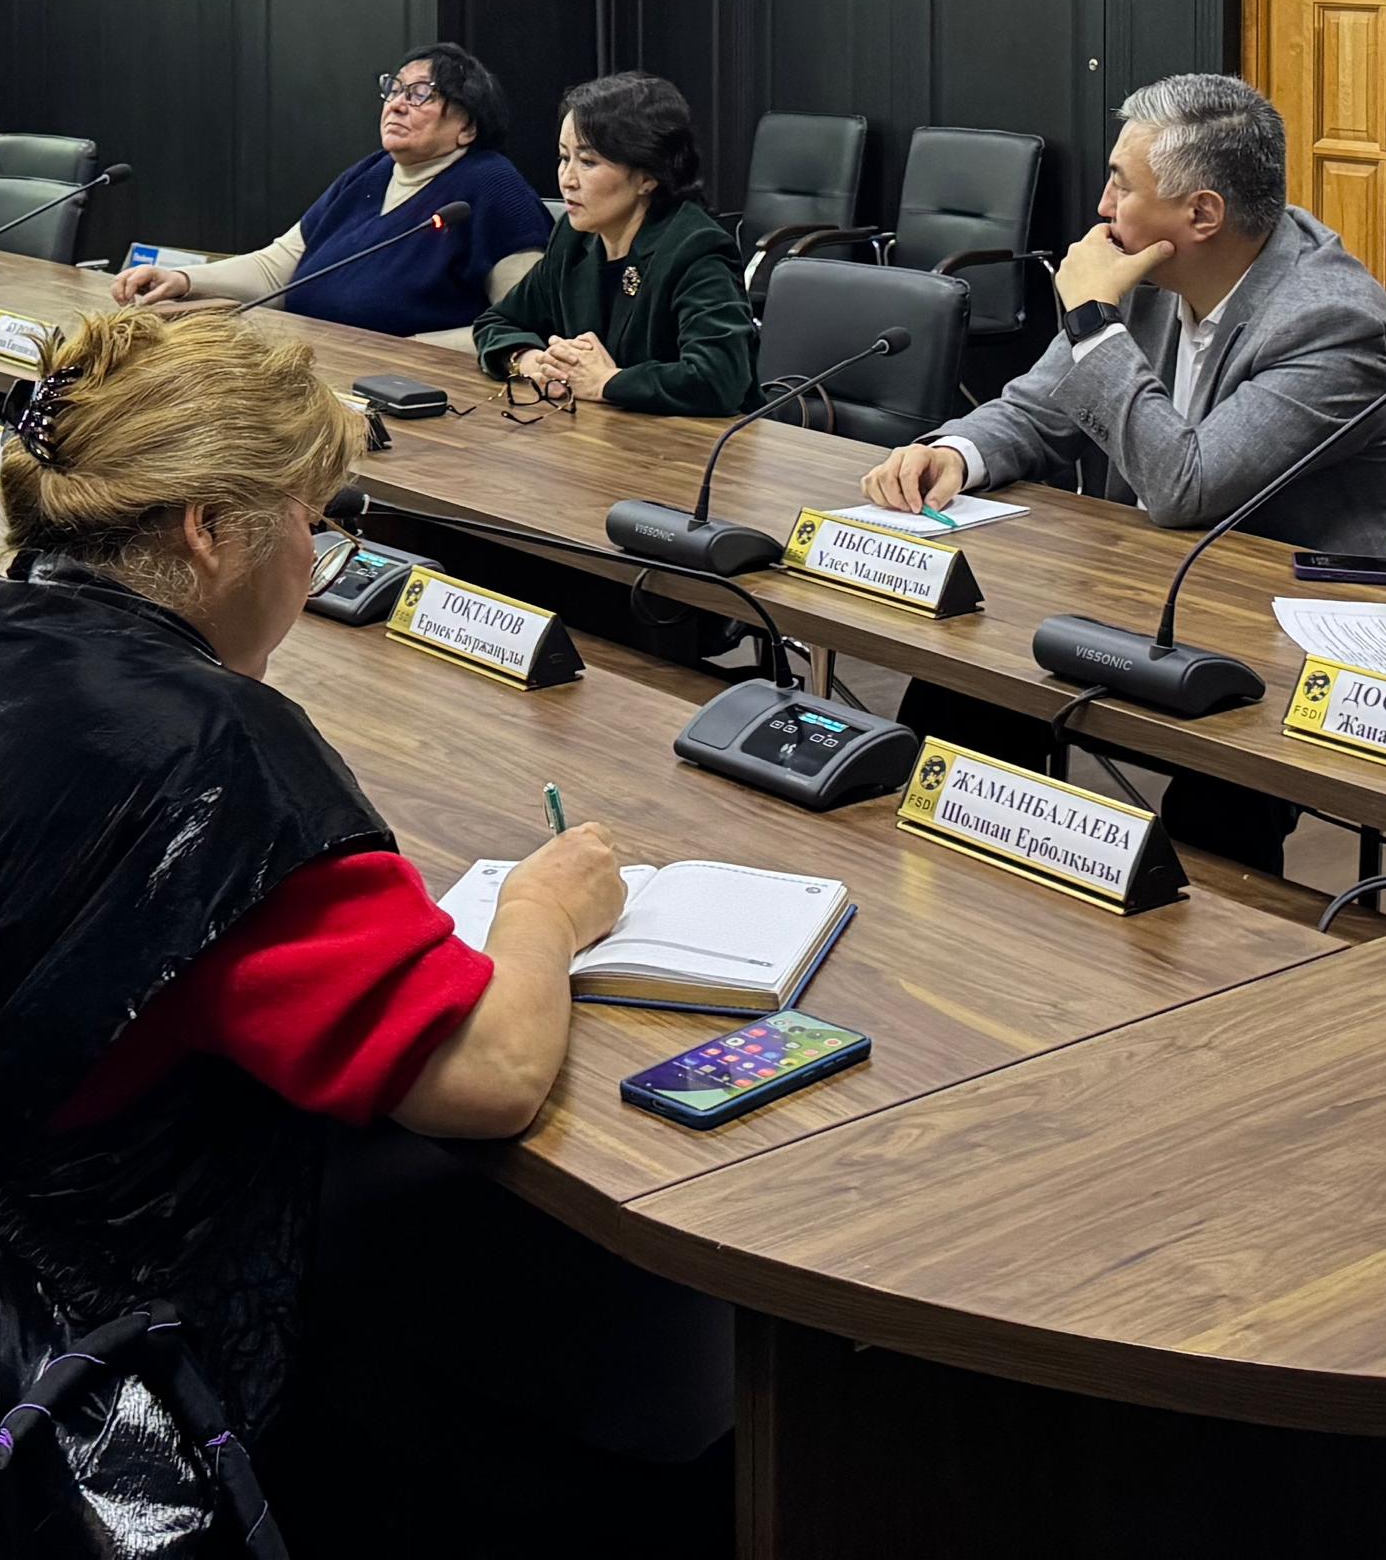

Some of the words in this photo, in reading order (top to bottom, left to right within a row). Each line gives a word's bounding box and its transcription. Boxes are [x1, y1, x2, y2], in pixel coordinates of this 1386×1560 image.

[833, 530, 933, 571] НЫСАНБЕК
[417, 613, 455, 639] Ермек
[442, 591, 525, 635] ТОҚТАРОВ
[1076, 645, 1133, 671] VISSONIC
[1293, 705, 1322, 721] FSDI
[952, 769, 1131, 851] ЖАМАНБАЛАЕВА
[941, 800, 1012, 843] Шолпан
[1015, 826, 1122, 885] Ерболқызы
